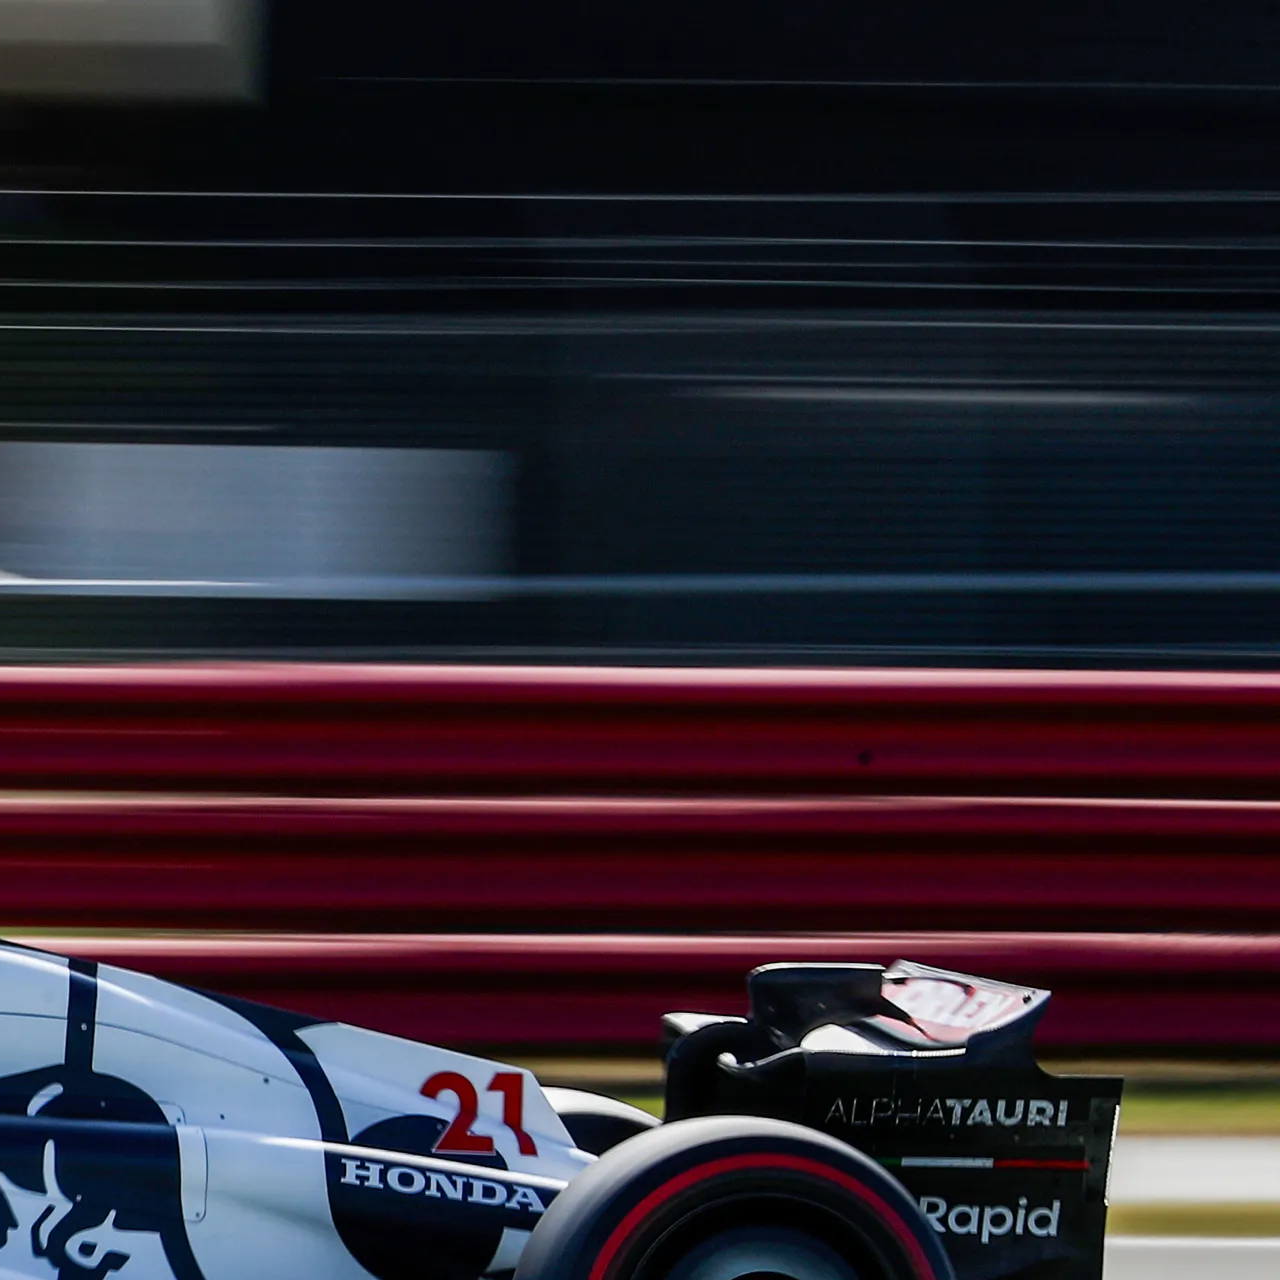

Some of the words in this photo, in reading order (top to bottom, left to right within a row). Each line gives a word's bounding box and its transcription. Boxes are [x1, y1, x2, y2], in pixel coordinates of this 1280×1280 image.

[420, 1070, 538, 1157] 21
[825, 1097, 1069, 1128] ALPHATAURI
[341, 1157, 546, 1214] HONDA
[919, 1196, 1062, 1244] Rapid
